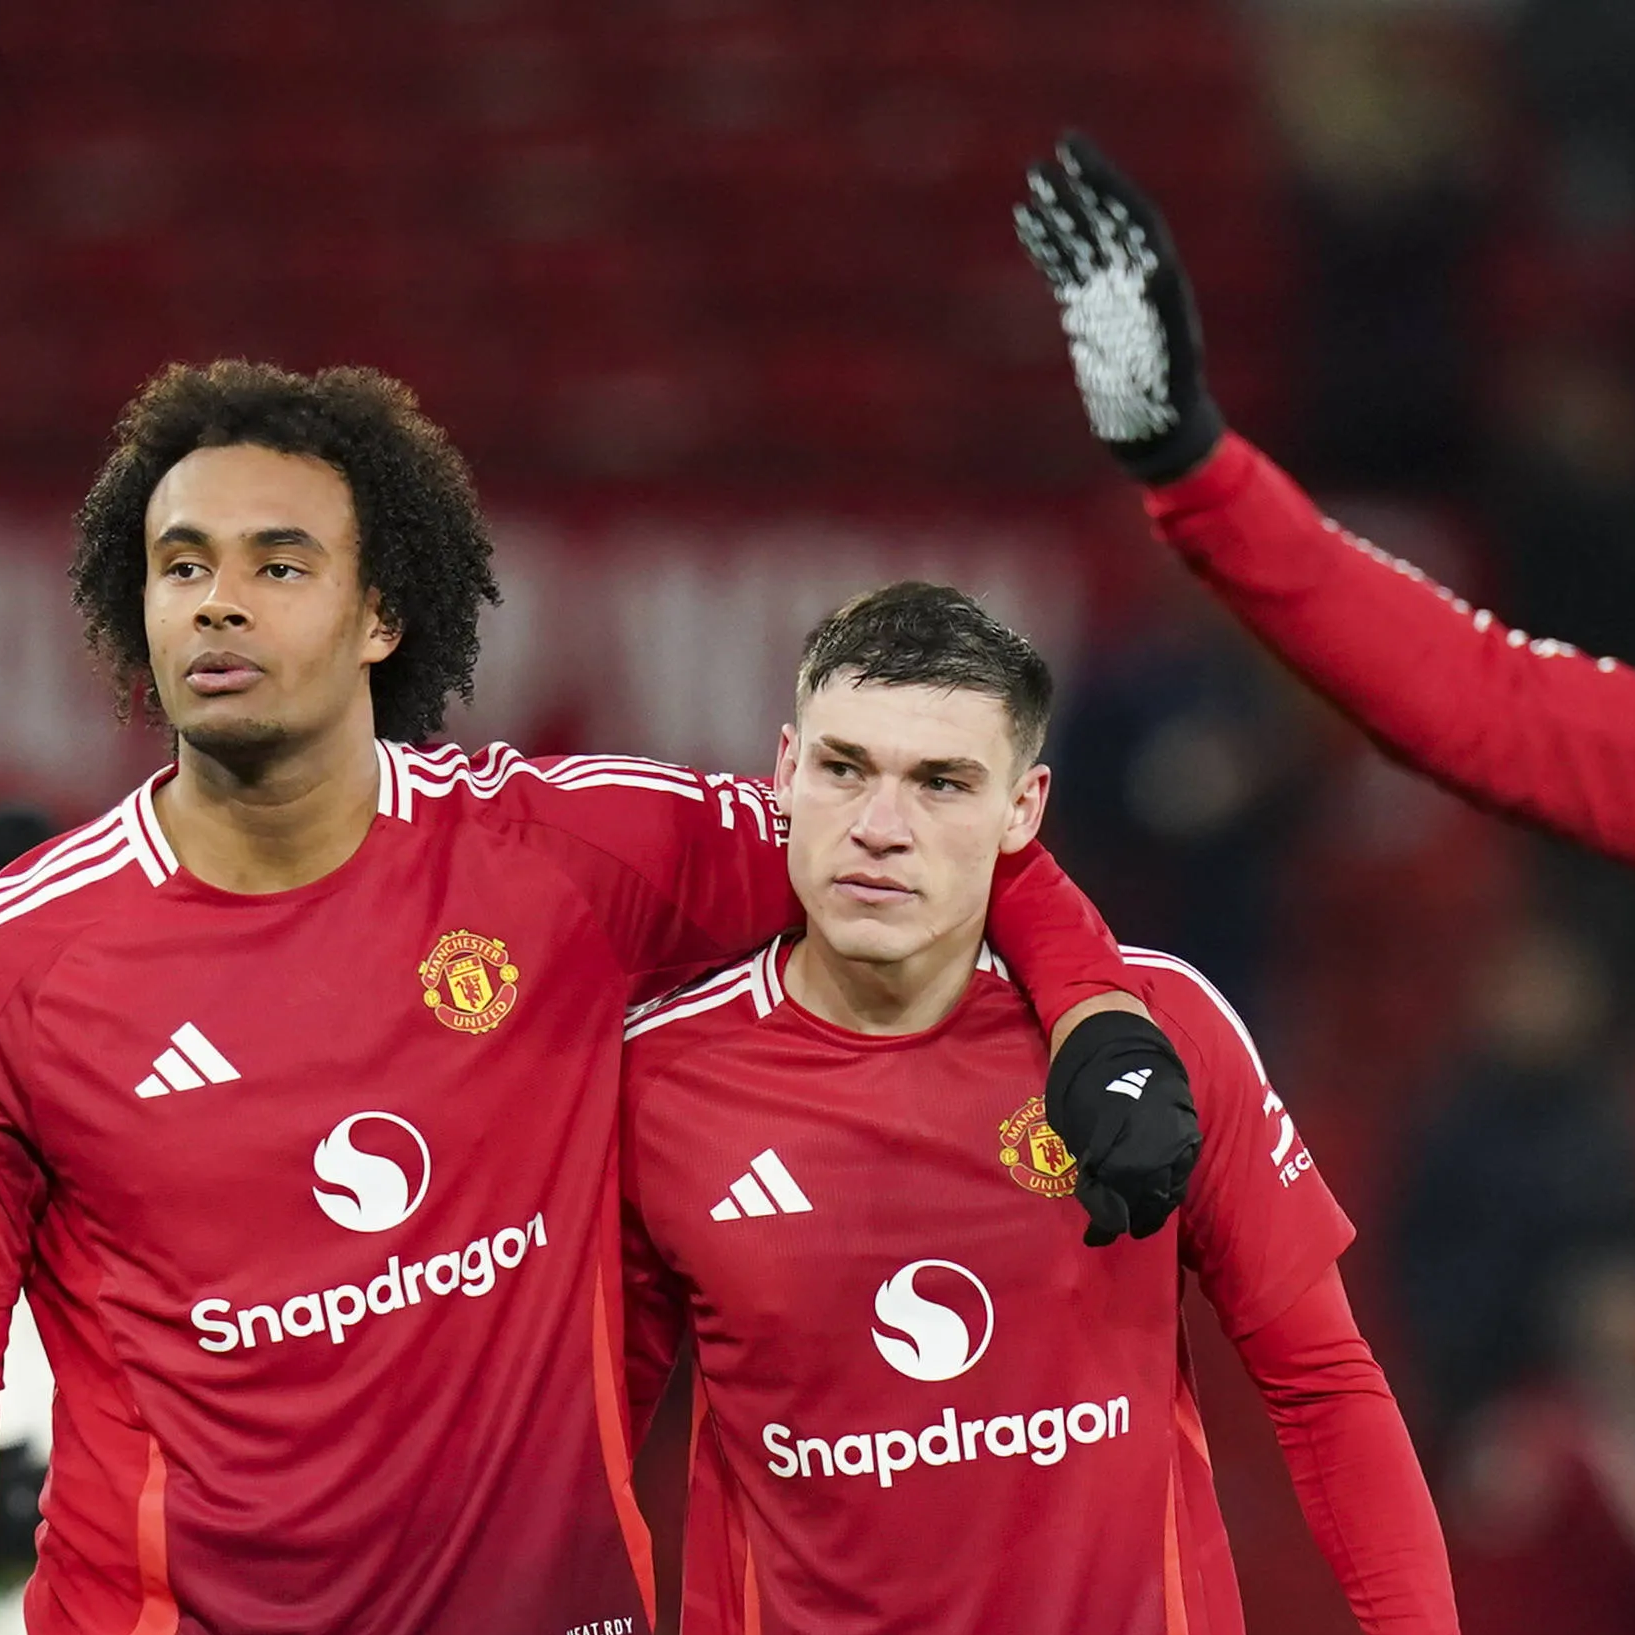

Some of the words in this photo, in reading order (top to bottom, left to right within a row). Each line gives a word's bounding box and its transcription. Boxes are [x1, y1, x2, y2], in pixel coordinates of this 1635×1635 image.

[427, 937, 501, 981] MANCHESTER
[453, 1001, 506, 1027] UNITED
[1007, 1103, 1045, 1140] MANC
[1029, 1172, 1078, 1190] UNITE
[191, 1211, 547, 1352] Snapdragon
[763, 1396, 1129, 1488] Snapdragon
